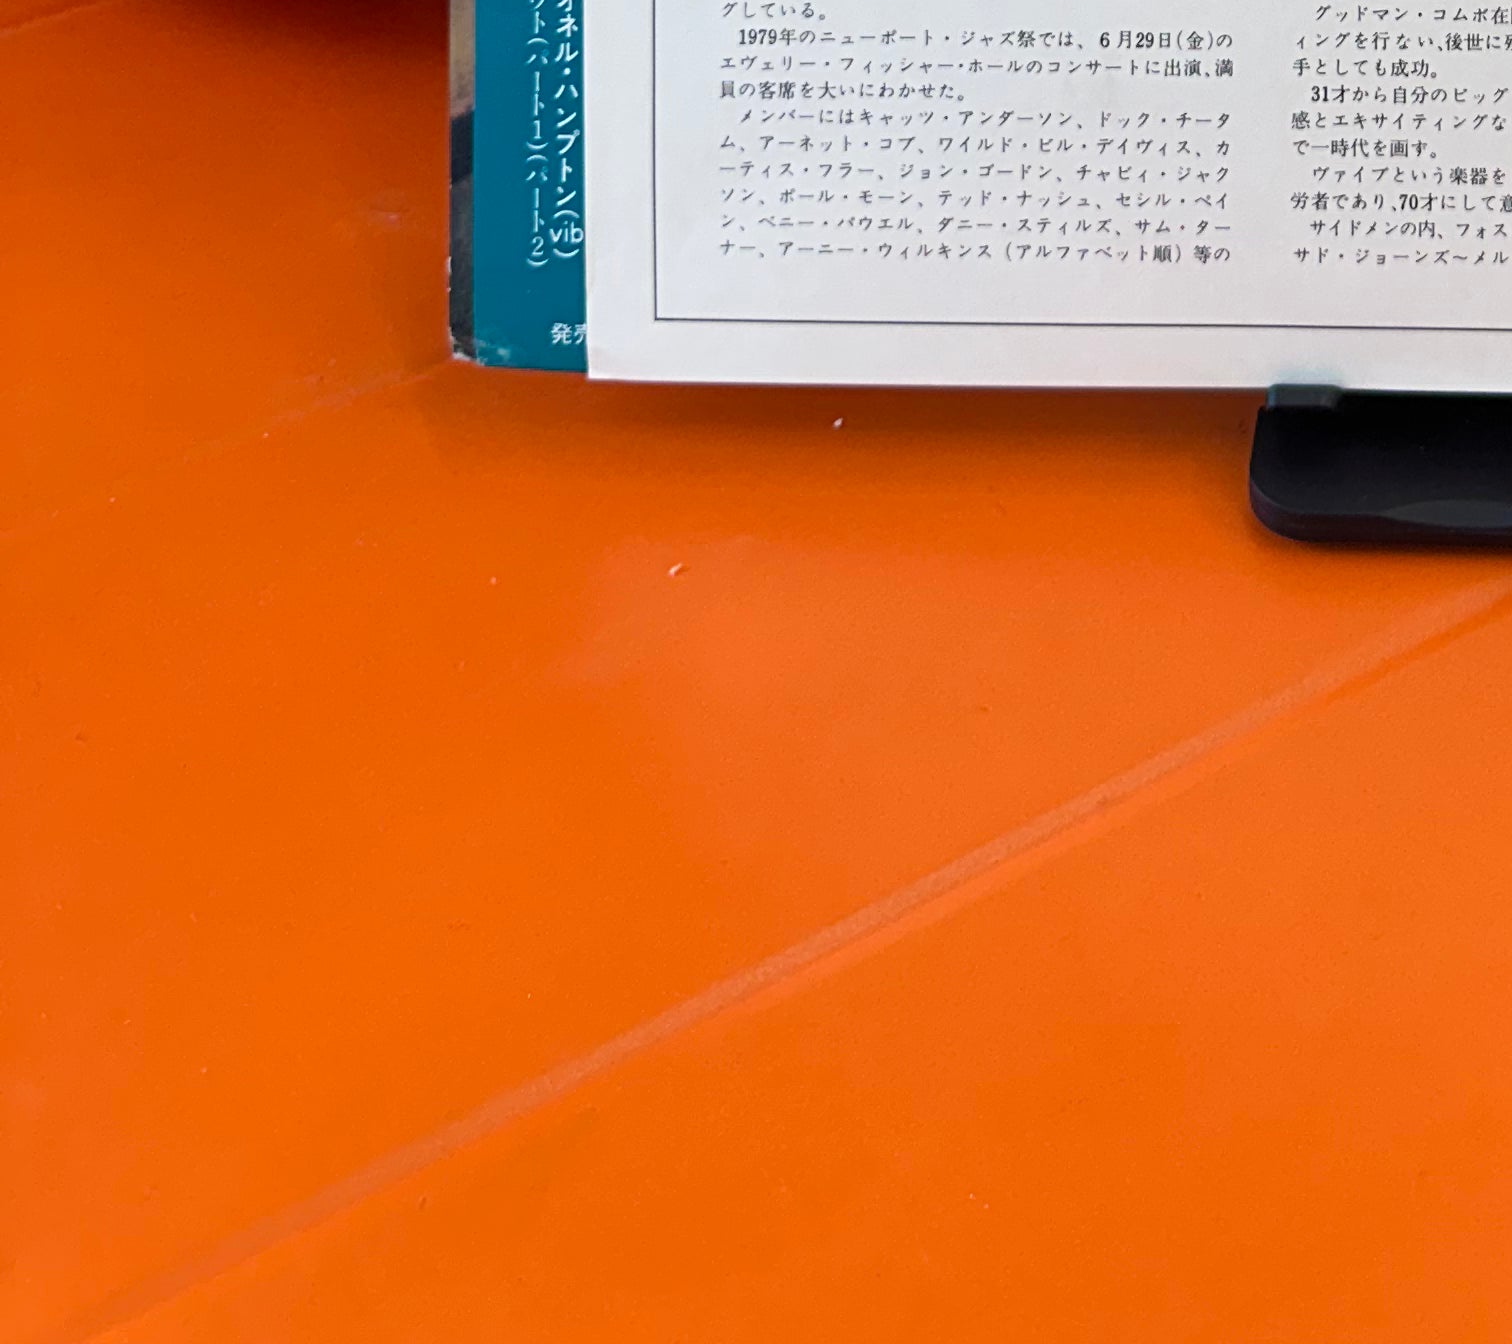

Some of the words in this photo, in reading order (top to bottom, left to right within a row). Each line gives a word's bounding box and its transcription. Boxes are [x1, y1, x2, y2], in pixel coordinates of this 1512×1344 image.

[723, 2, 825, 20] グしている。
[1293, 58, 1437, 79] 手としても成功。
[1293, 138, 1436, 159] で一時代を画す。
